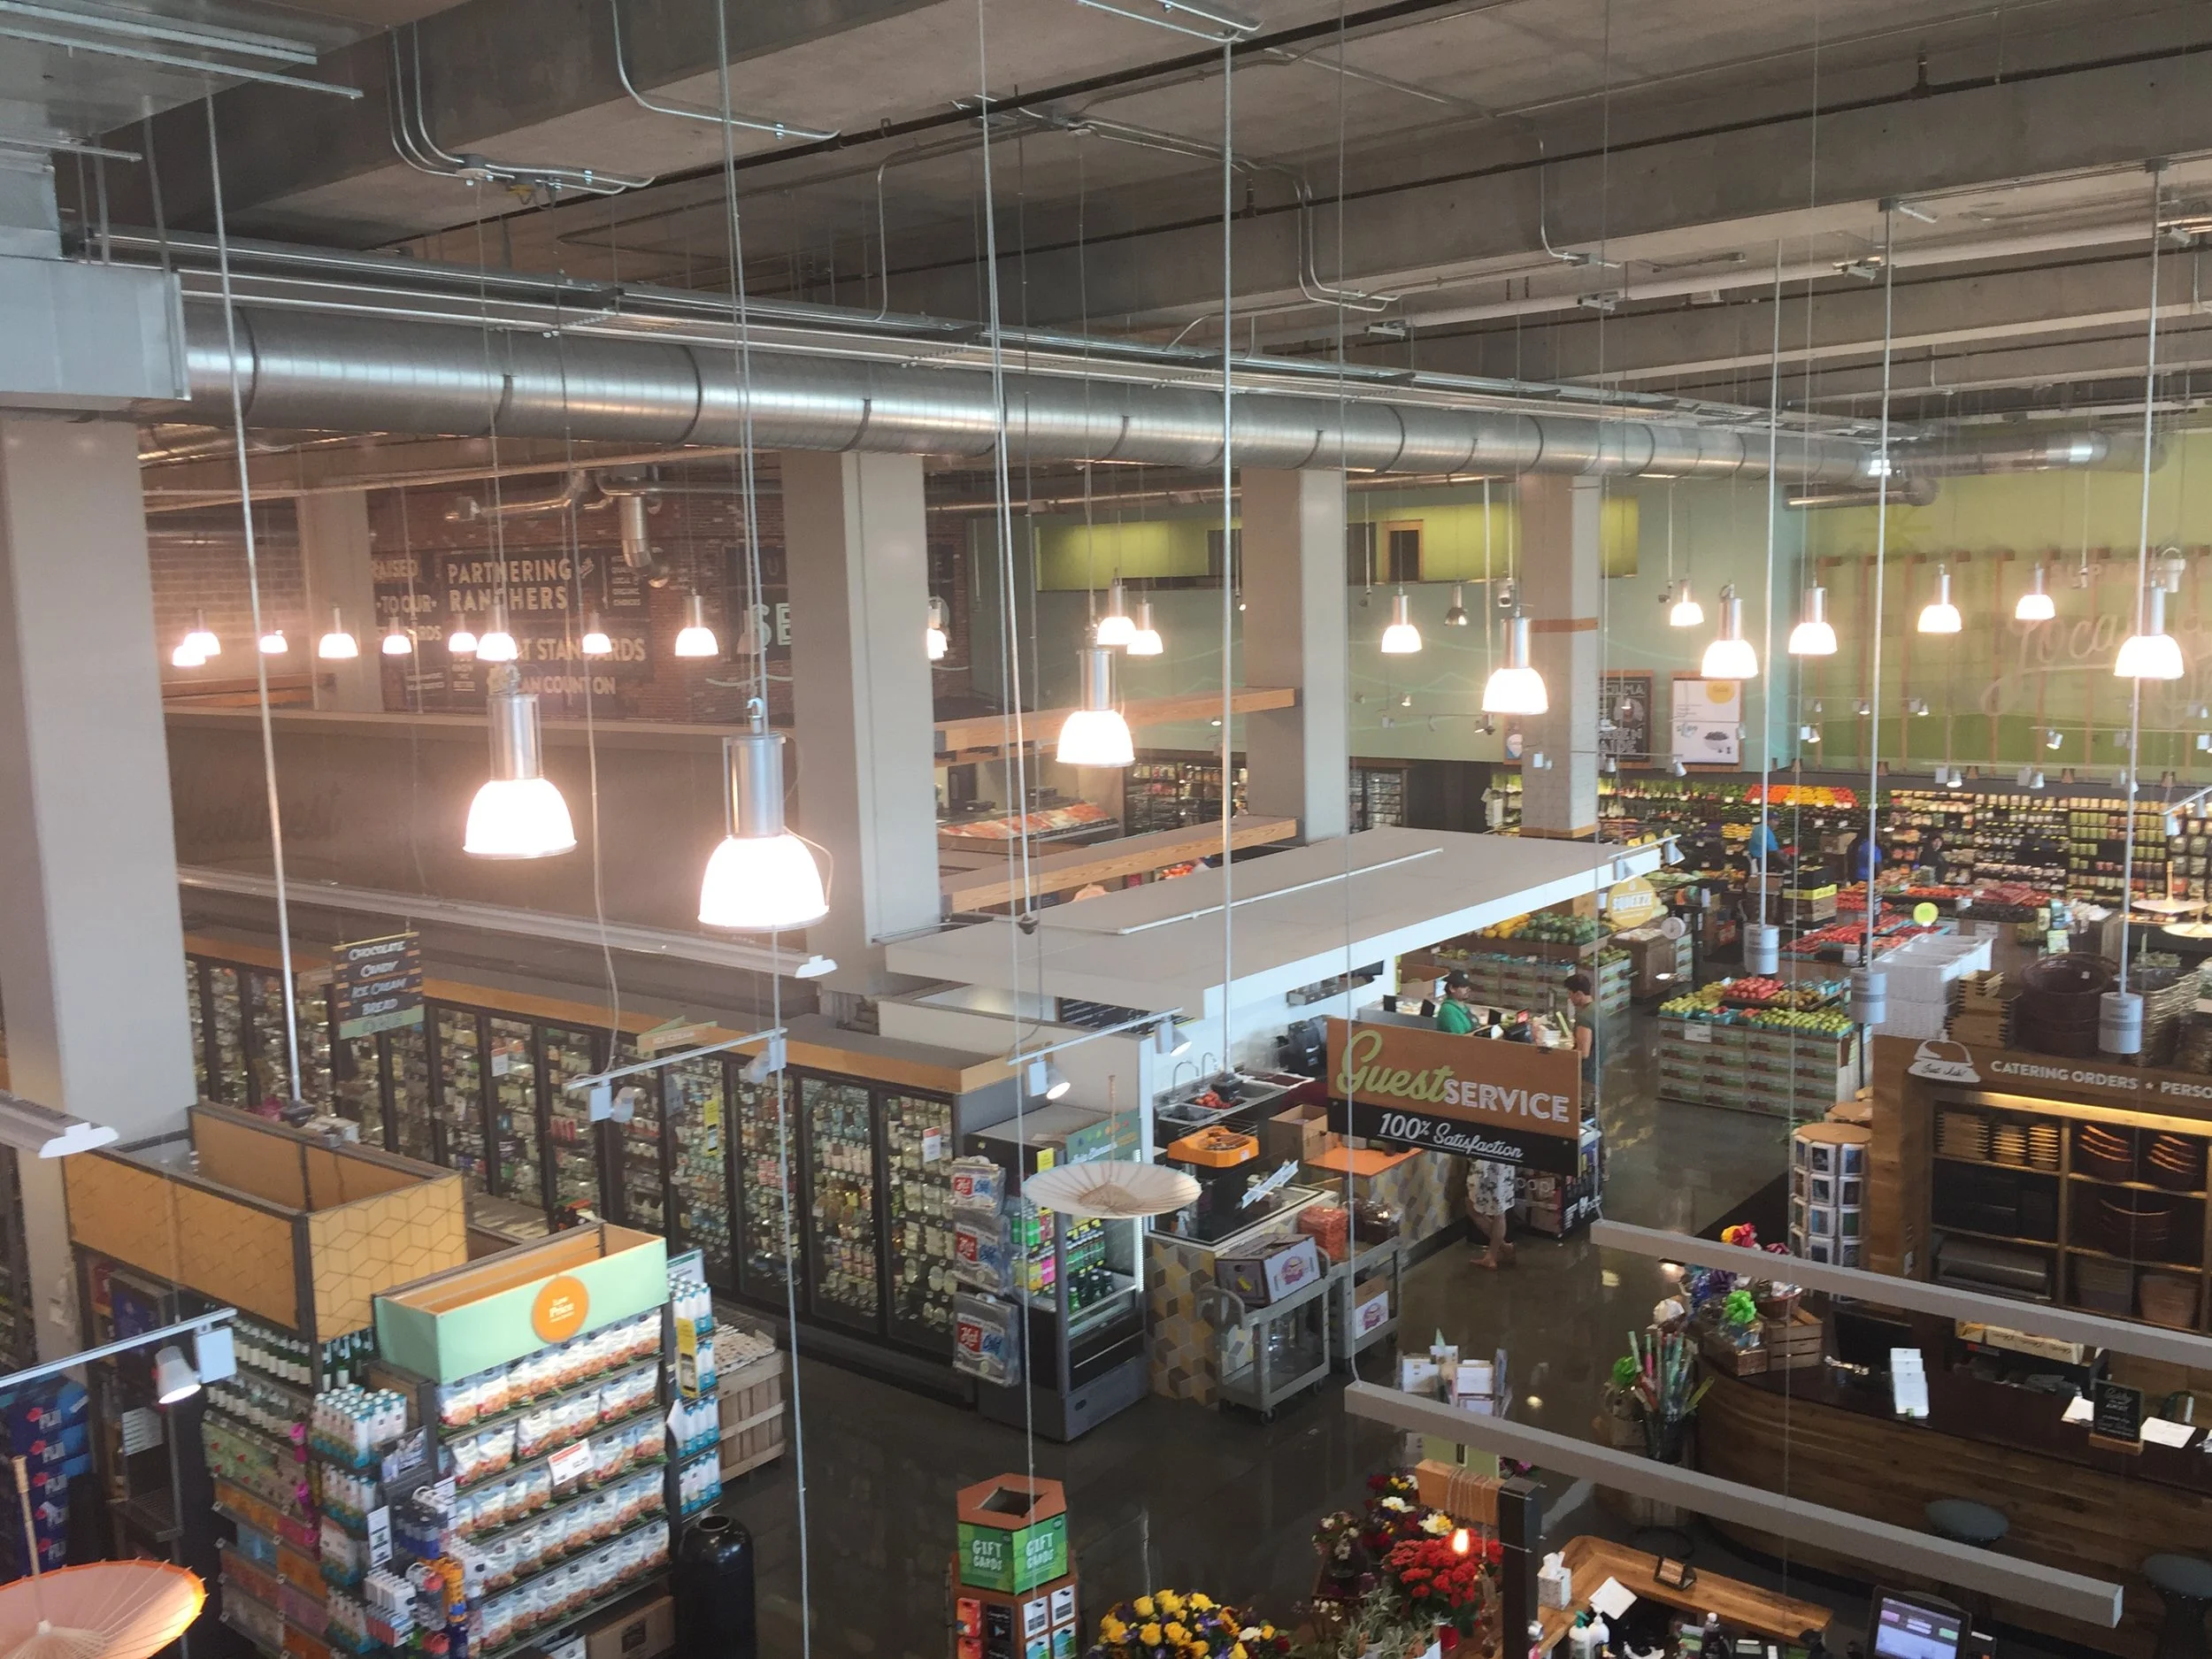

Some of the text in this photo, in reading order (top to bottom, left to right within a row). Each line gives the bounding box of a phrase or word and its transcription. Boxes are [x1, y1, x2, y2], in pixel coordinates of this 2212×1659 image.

[447, 558, 572, 584] PARTNERING
[380, 594, 433, 613] TO OUR
[449, 586, 568, 612] RANHERS
[536, 637, 647, 662] STANRDS
[543, 675, 592, 695] COUNT
[593, 677, 617, 695] ON
[1336, 1030, 1571, 1123] Guest SERVICE
[1990, 1060, 2212, 1100] CATERING ORDERS PERSO
[1379, 1111, 1525, 1159] 100% Satisfaction
[972, 1540, 1002, 1556] GIFT
[1025, 1532, 1055, 1557] GIFT
[973, 1555, 1003, 1571] CARDS
